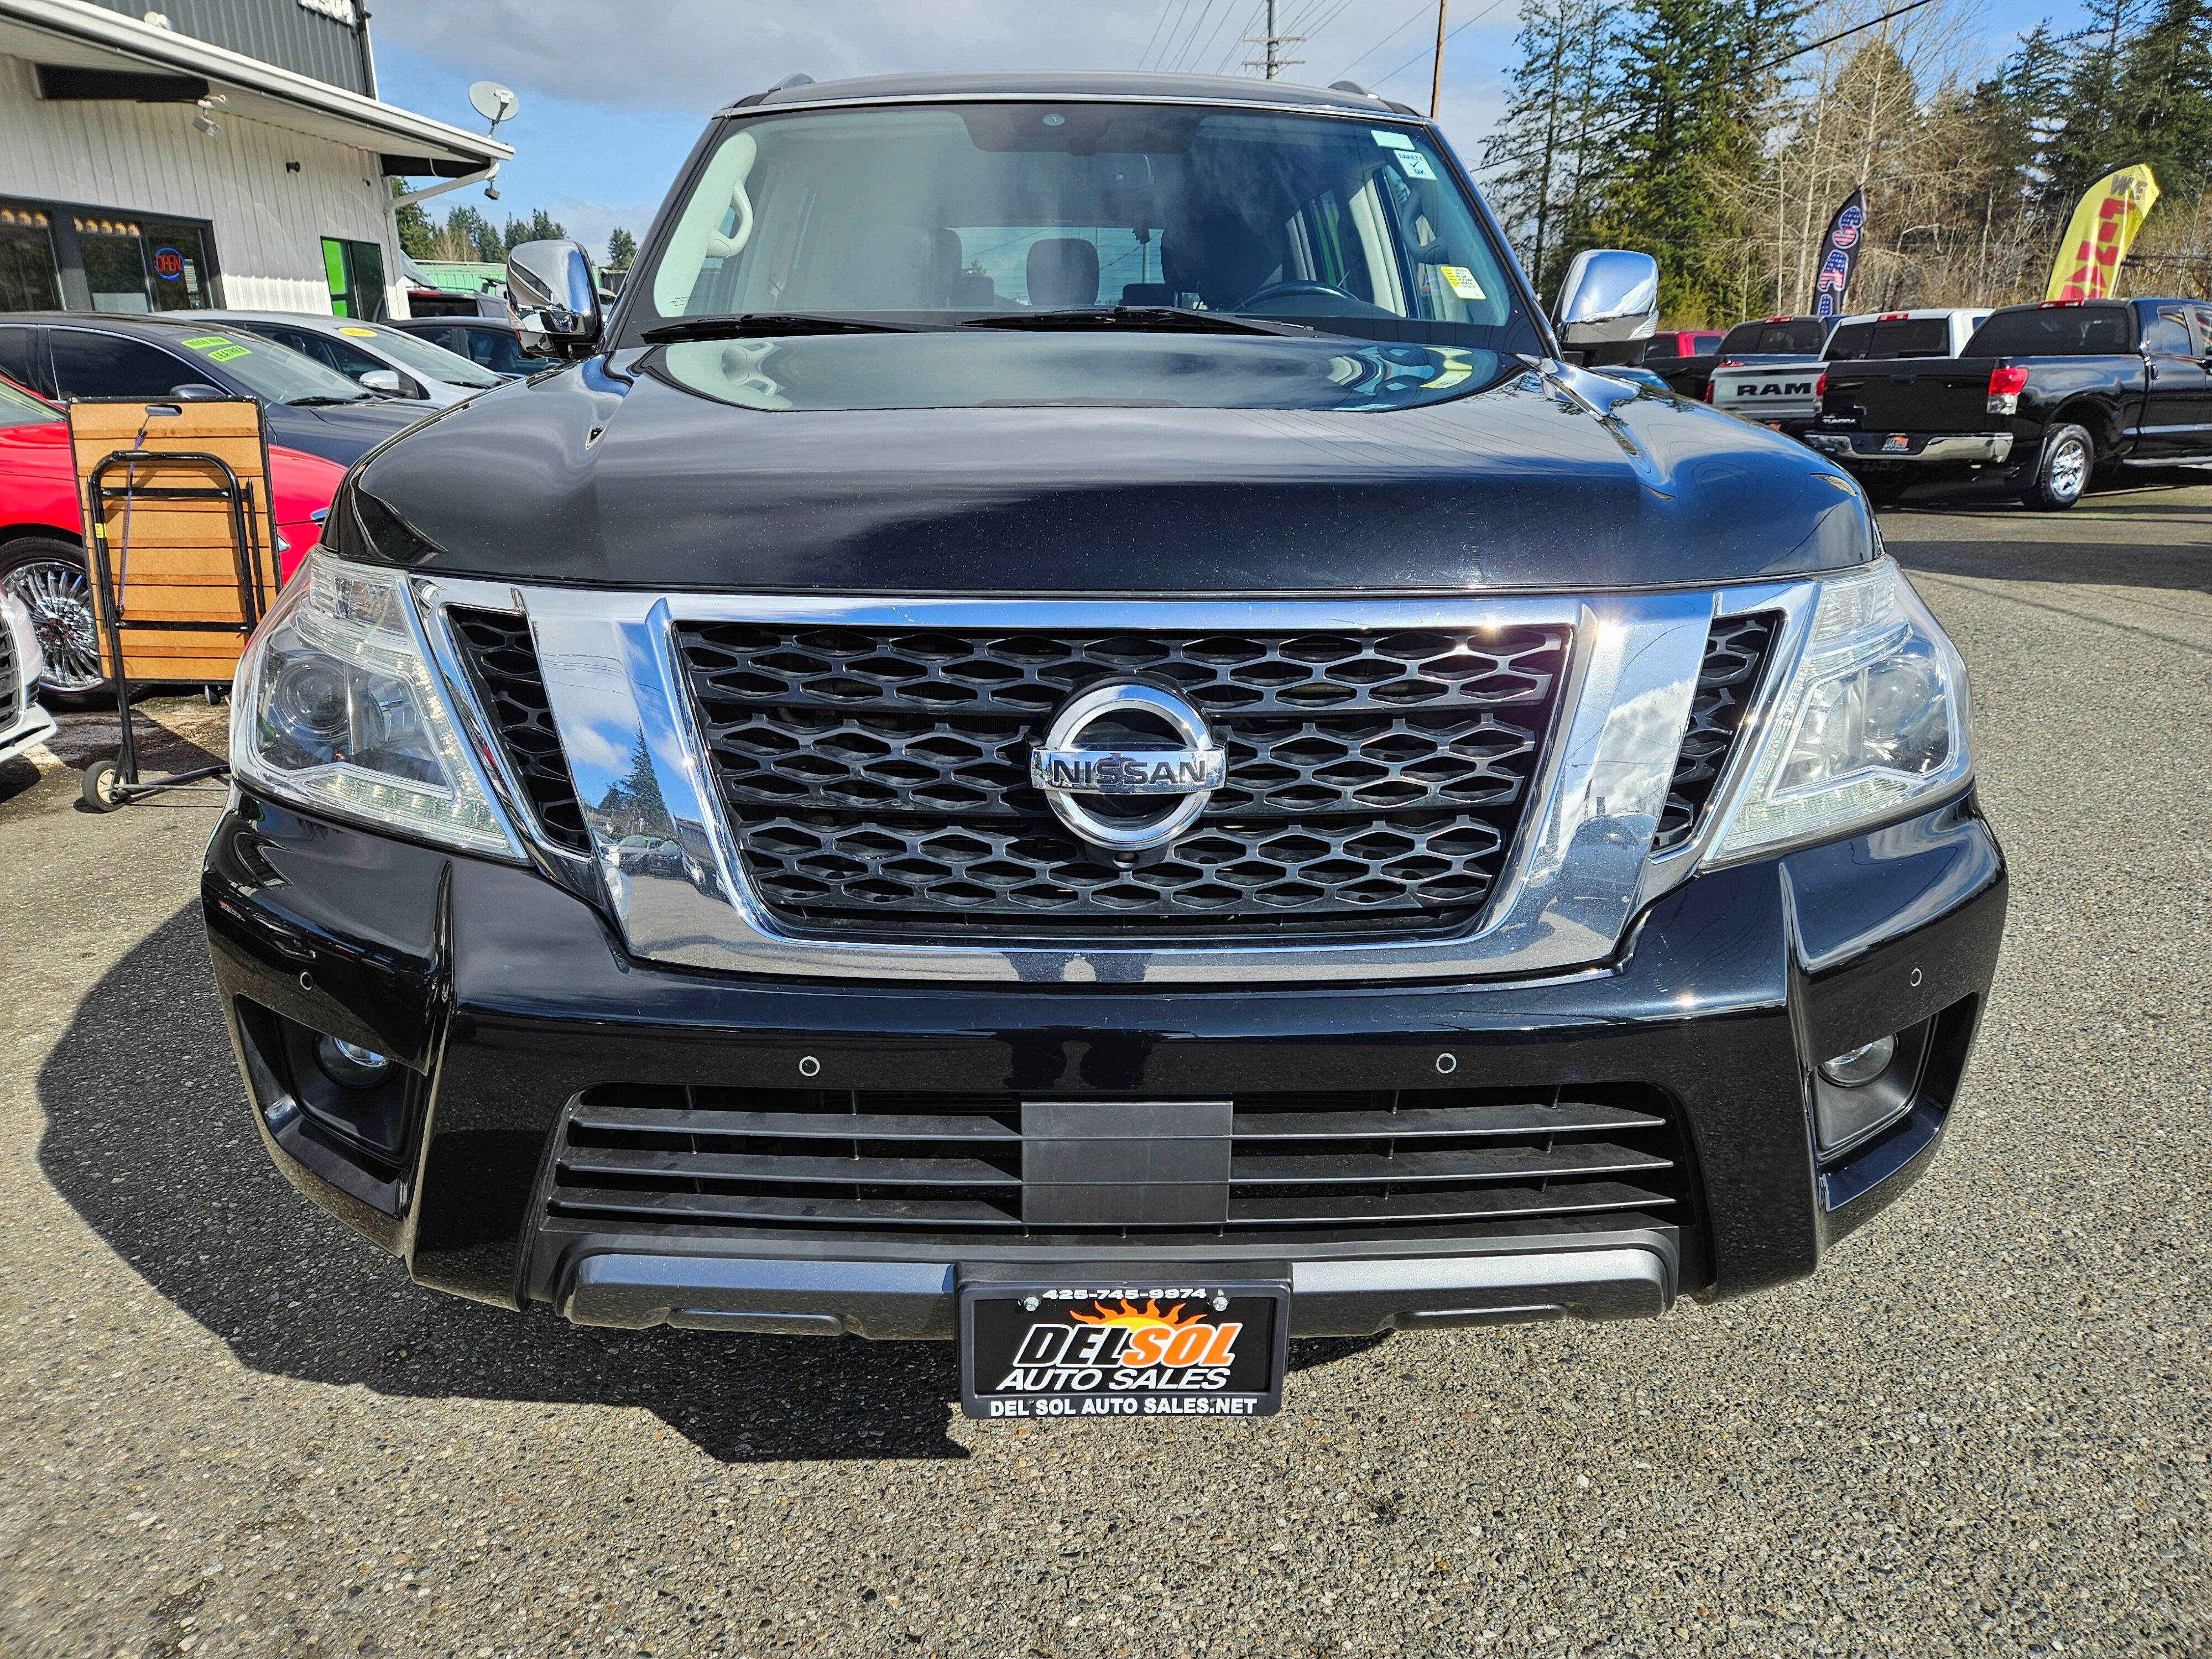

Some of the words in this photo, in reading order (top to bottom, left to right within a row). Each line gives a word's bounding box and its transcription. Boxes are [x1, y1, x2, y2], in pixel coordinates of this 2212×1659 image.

[156, 255, 181, 272] OPEN
[212, 346, 247, 359] LEATHER
[1737, 383, 1812, 396] RAM
[1053, 760, 1206, 785] NISSAN
[1042, 1289, 1207, 1300] 425-745-9974
[996, 1369, 1102, 1390] AUTO
[1108, 1368, 1230, 1390] SALES
[990, 1400, 1030, 1416] DEL
[1035, 1399, 1076, 1416] SOL
[1081, 1397, 1138, 1415] AUTO
[1144, 1397, 1258, 1415] SALES.NET
